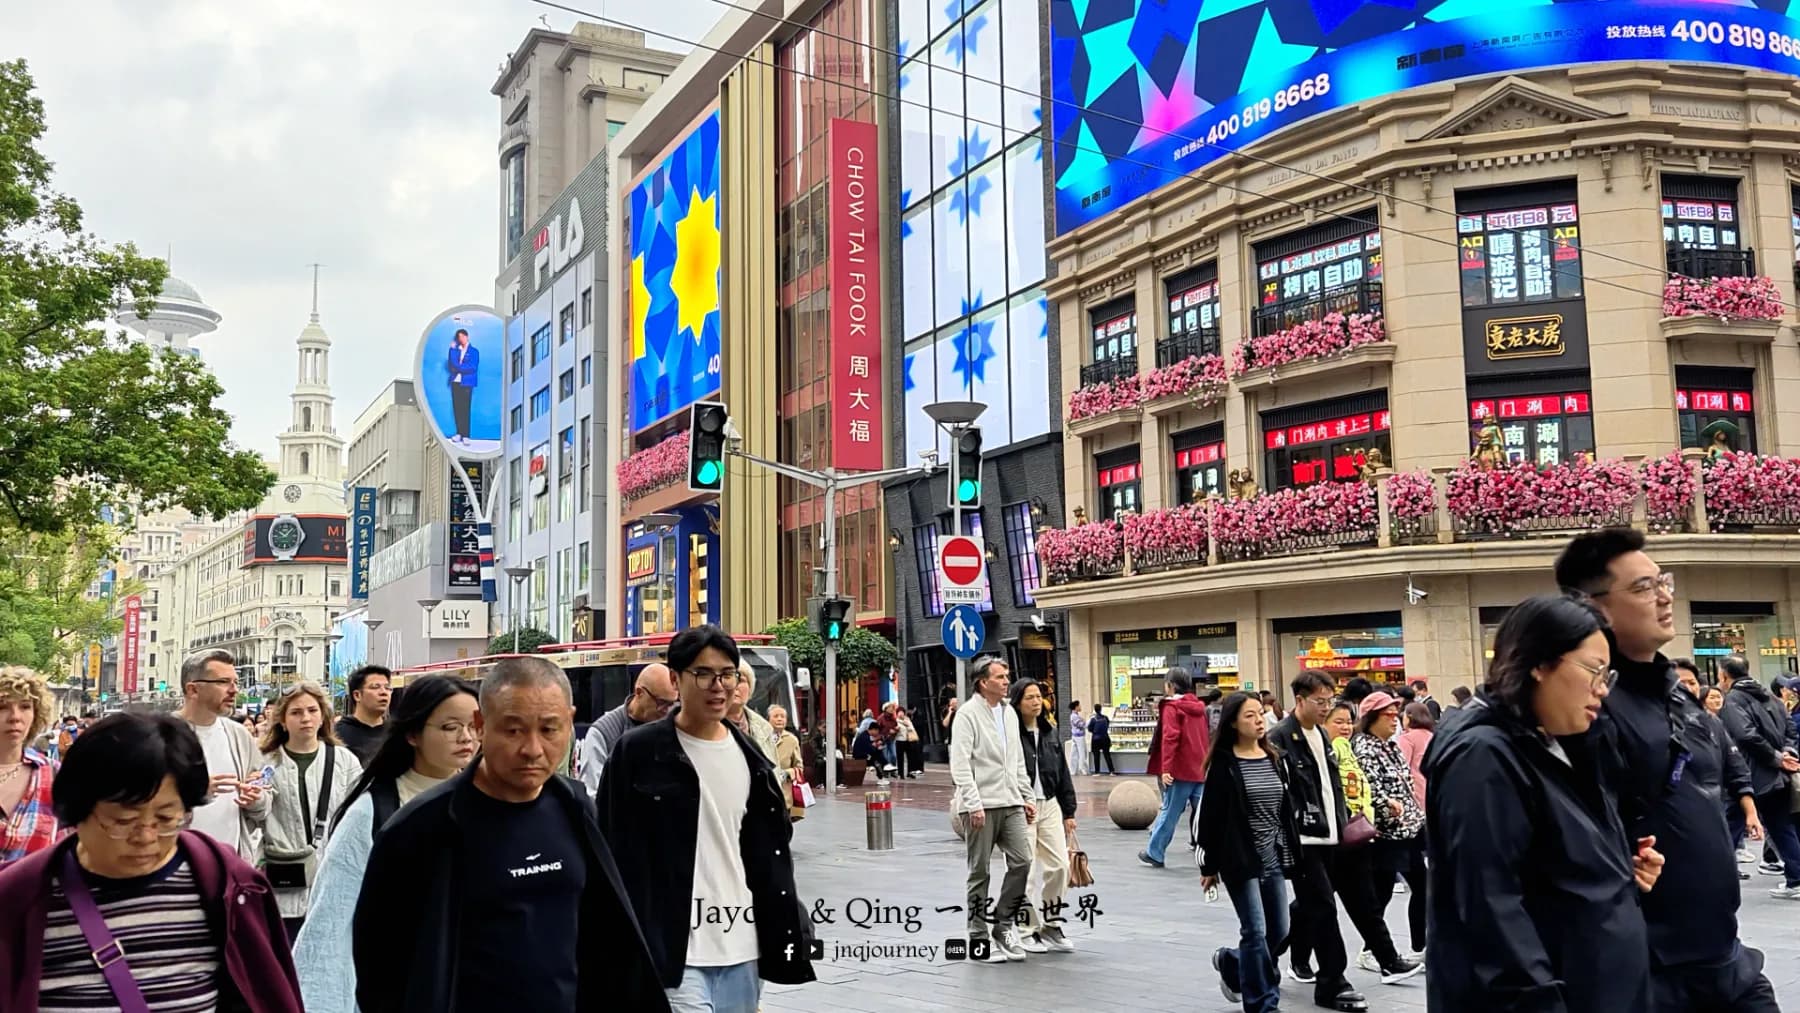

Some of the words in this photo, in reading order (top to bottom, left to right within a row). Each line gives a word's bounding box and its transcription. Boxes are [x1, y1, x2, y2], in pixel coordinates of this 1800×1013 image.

[1606, 25, 1666, 39] 投放热线
[1671, 20, 1724, 44] 400
[1728, 24, 1765, 50] 819
[1207, 114, 1239, 144] 400
[1242, 97, 1271, 128] 819
[1274, 73, 1331, 112] 8668
[847, 147, 865, 222] CHOW
[534, 197, 585, 291] FILA
[848, 228, 865, 263] TAI
[1462, 237, 1484, 248] 入口
[1554, 227, 1578, 239] 入口
[1283, 258, 1363, 298] 烤肉自助
[848, 272, 866, 337] FOOK
[849, 355, 870, 442] 周大福
[443, 609, 470, 620] LILY
[509, 861, 562, 877] TRAINING
